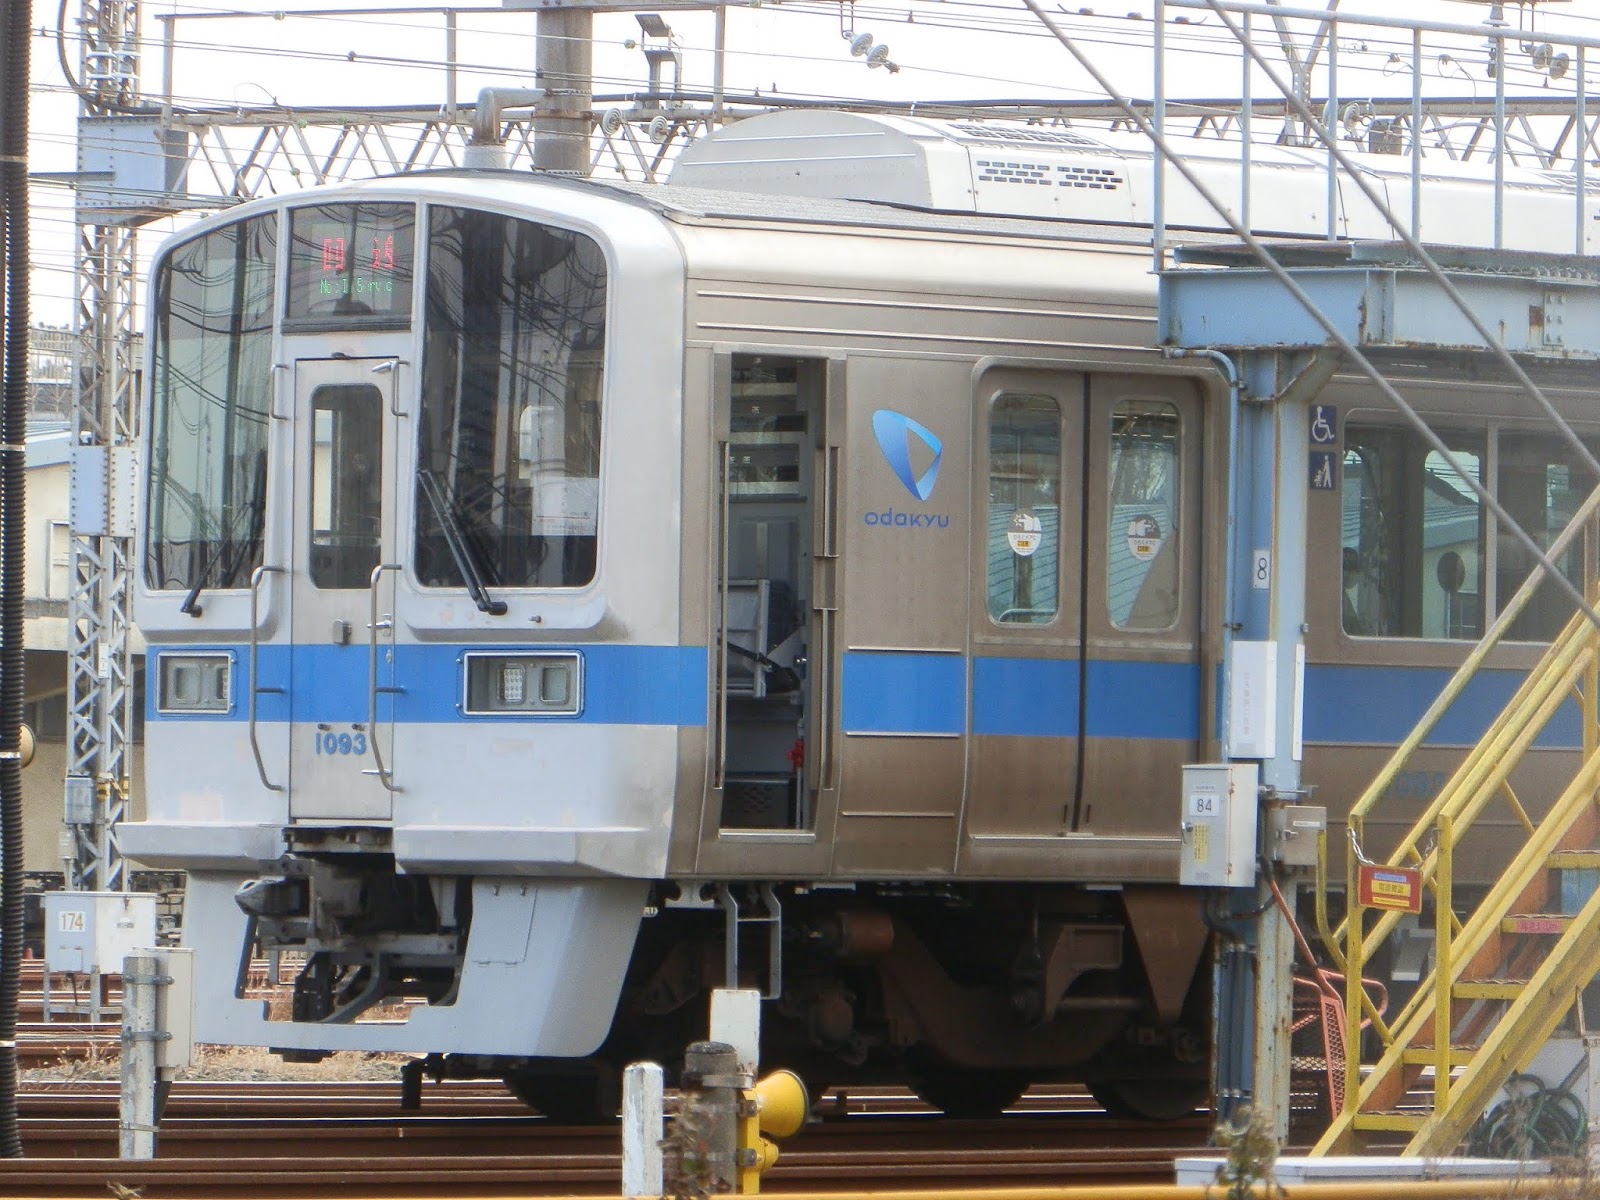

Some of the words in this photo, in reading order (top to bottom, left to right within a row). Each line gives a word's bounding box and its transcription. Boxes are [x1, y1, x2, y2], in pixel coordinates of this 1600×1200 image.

[864, 506, 950, 528] odakyu
[1257, 557, 1267, 580] 8
[315, 732, 367, 756] 1093
[1196, 798, 1212, 813] 84
[61, 912, 83, 931] 174
